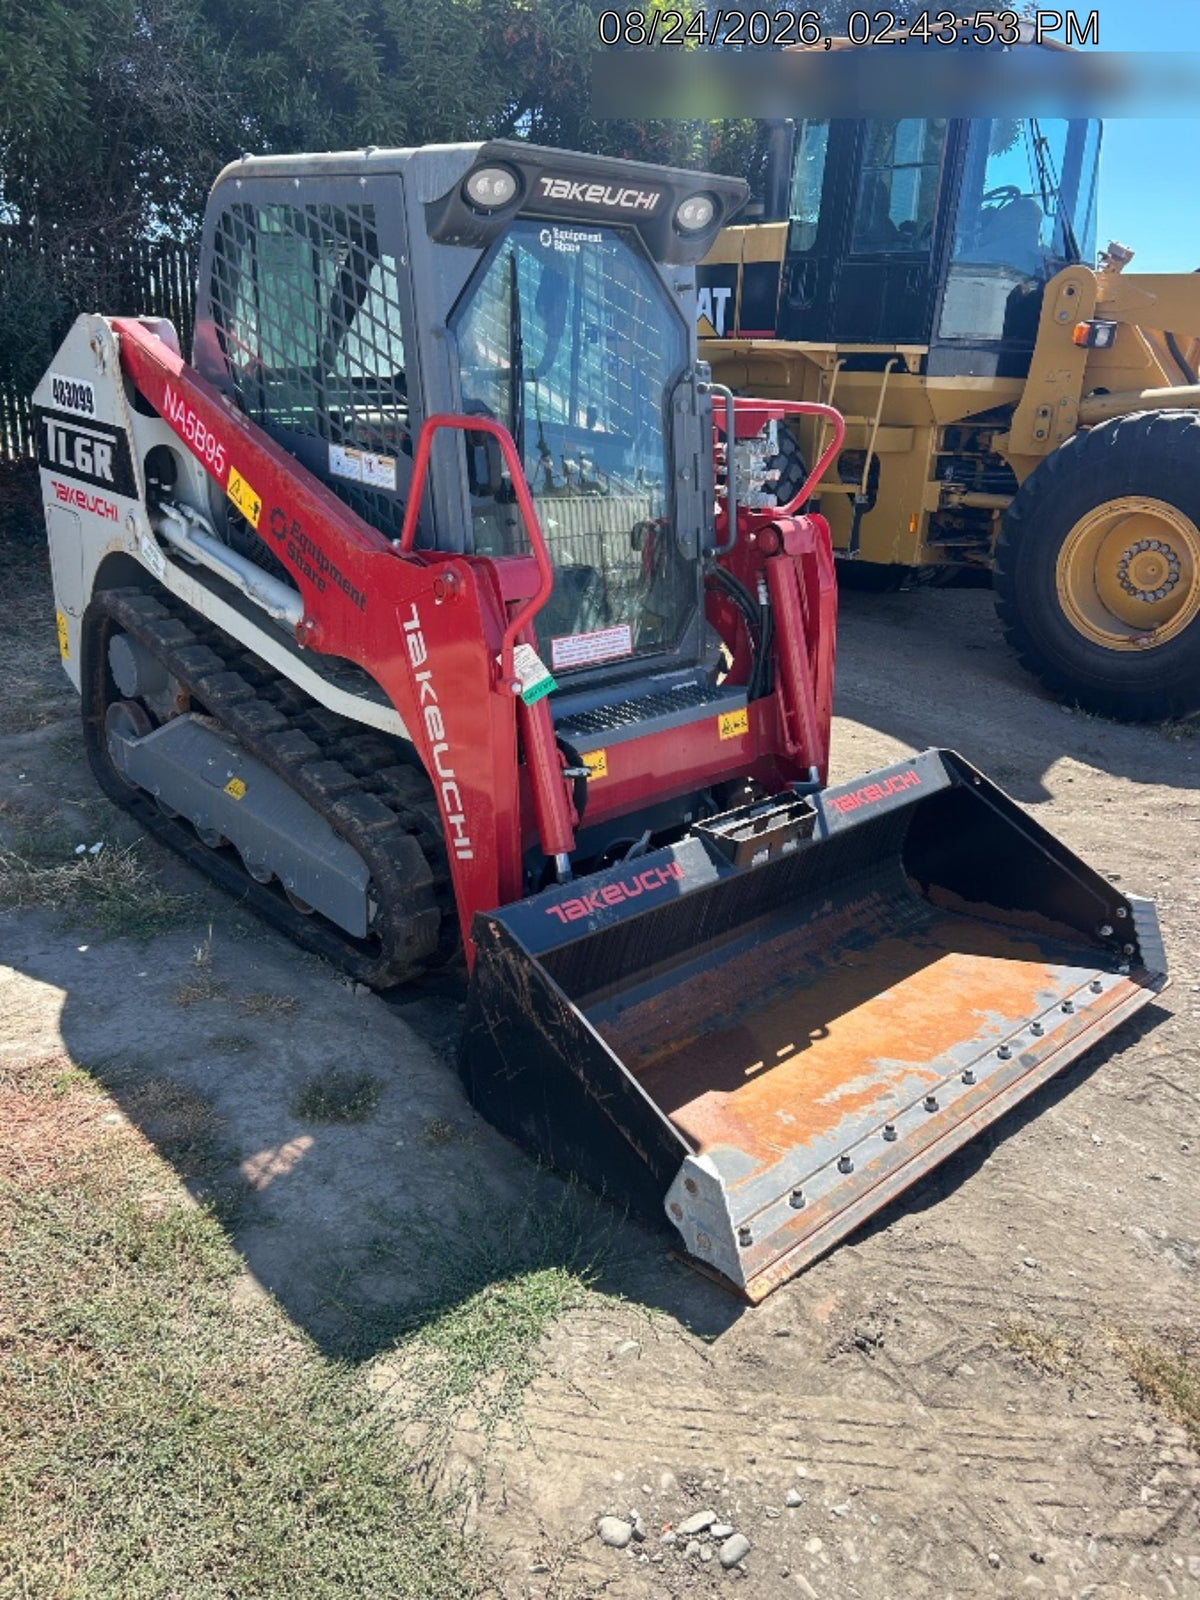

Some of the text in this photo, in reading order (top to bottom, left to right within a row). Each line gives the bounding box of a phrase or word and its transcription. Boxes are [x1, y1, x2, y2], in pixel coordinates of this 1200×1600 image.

[540, 177, 660, 211] TAKEUCHI
[552, 227, 603, 243] Equipment
[553, 240, 581, 252] Share
[696, 287, 732, 338] AT
[52, 378, 95, 415] 483099
[41, 416, 118, 483] TL6R
[163, 384, 227, 475] NA5B95
[51, 480, 120, 523] TAKEUCHI
[286, 540, 328, 593] Share
[290, 519, 368, 611] Equipment
[403, 602, 474, 860] TAKEUCHI
[825, 770, 922, 815] TAKEUCHI
[545, 861, 685, 925] TAKEUCHI
